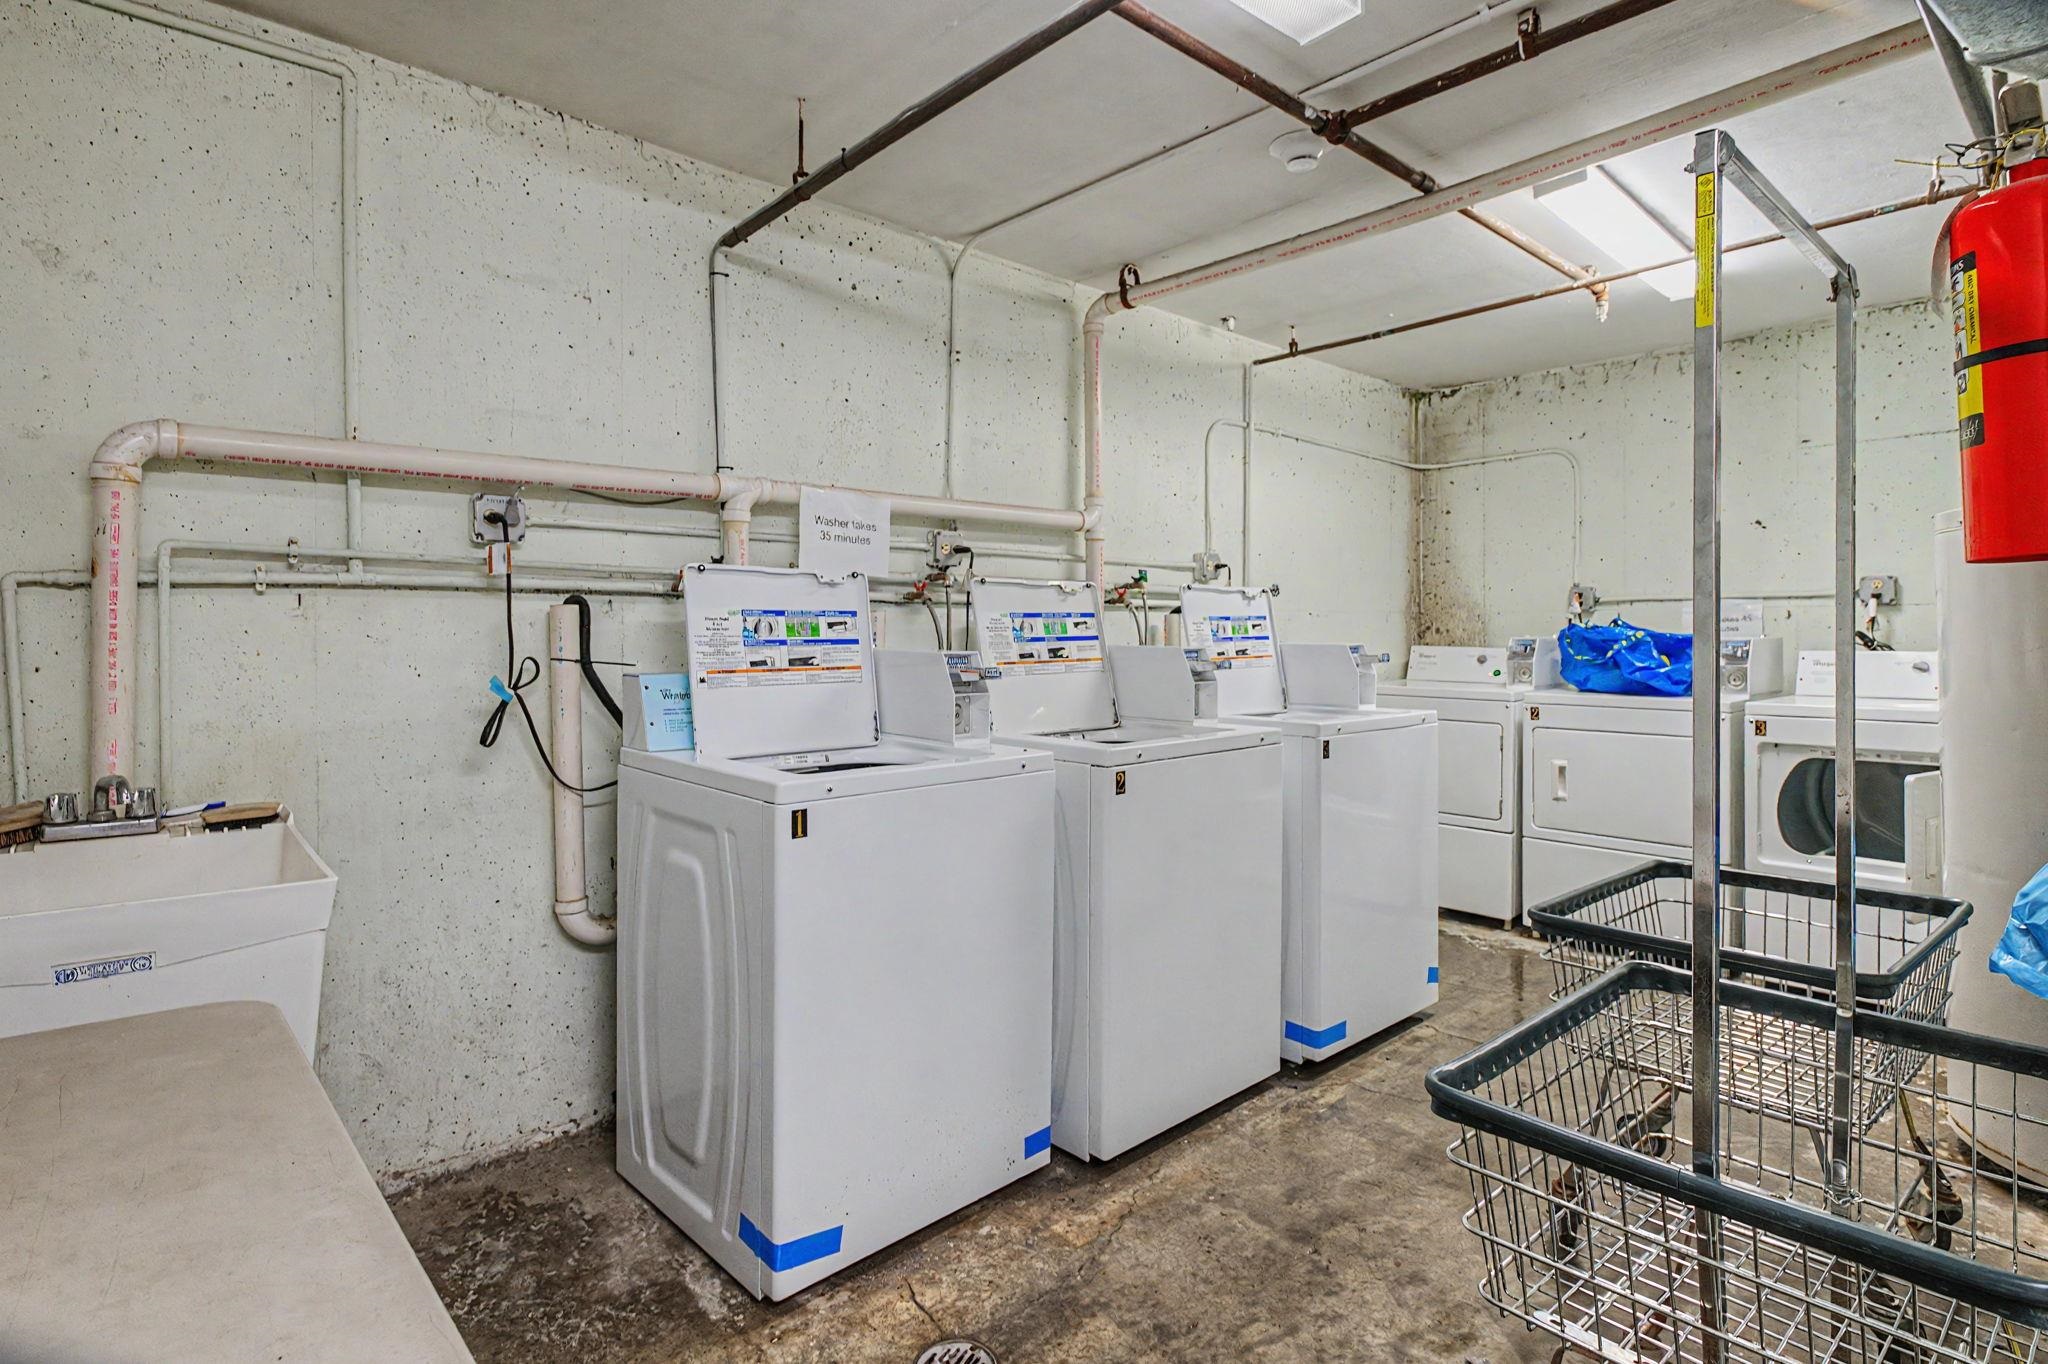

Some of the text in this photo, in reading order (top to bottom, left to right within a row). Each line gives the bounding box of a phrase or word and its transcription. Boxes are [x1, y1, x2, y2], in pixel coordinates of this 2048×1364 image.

[814, 514, 877, 532] Washer takes
[819, 529, 871, 546] 35 minutes
[1531, 707, 1539, 720] 2
[1755, 720, 1766, 735] 3
[1116, 772, 1125, 794] 2
[795, 810, 804, 837] 1
